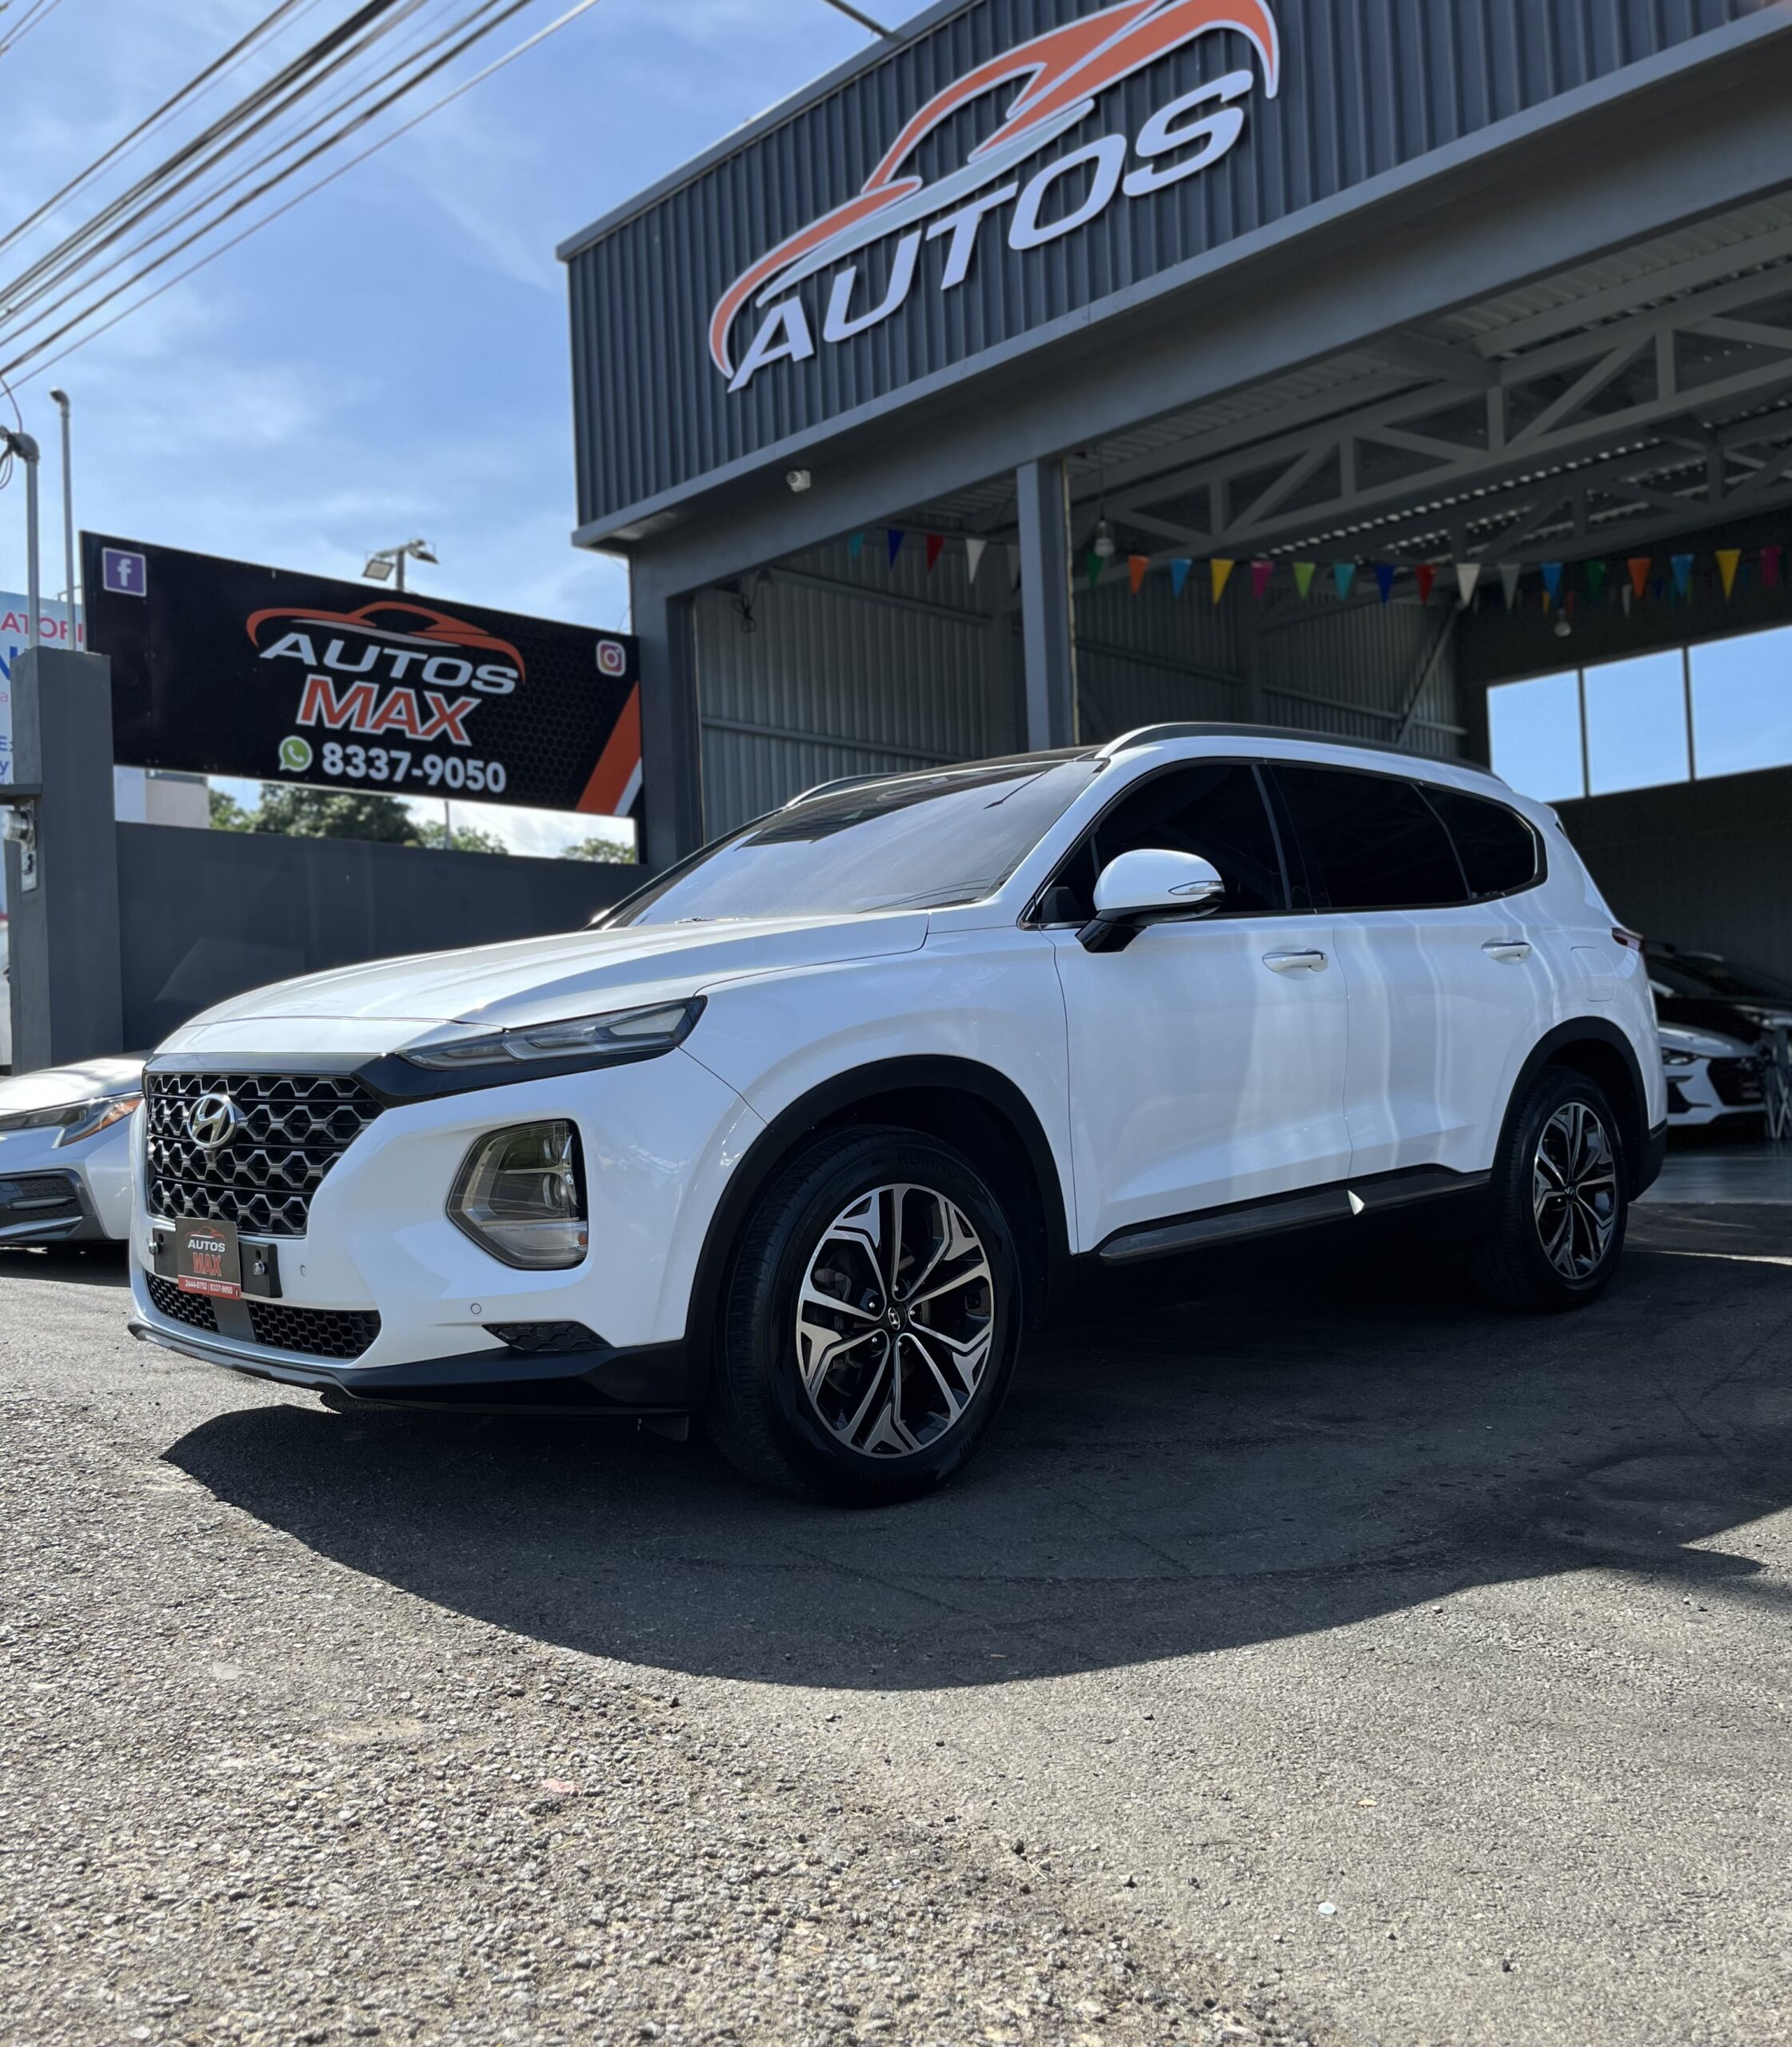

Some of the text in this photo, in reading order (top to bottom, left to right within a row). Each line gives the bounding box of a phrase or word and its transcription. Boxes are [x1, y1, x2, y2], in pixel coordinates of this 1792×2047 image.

[727, 70, 1254, 393] AUTOS
[259, 632, 519, 695] AUTOS
[296, 673, 481, 746] MAX
[321, 741, 506, 793] 8337-9050
[188, 1239, 225, 1252] AUTOS
[193, 1252, 222, 1276] MAX
